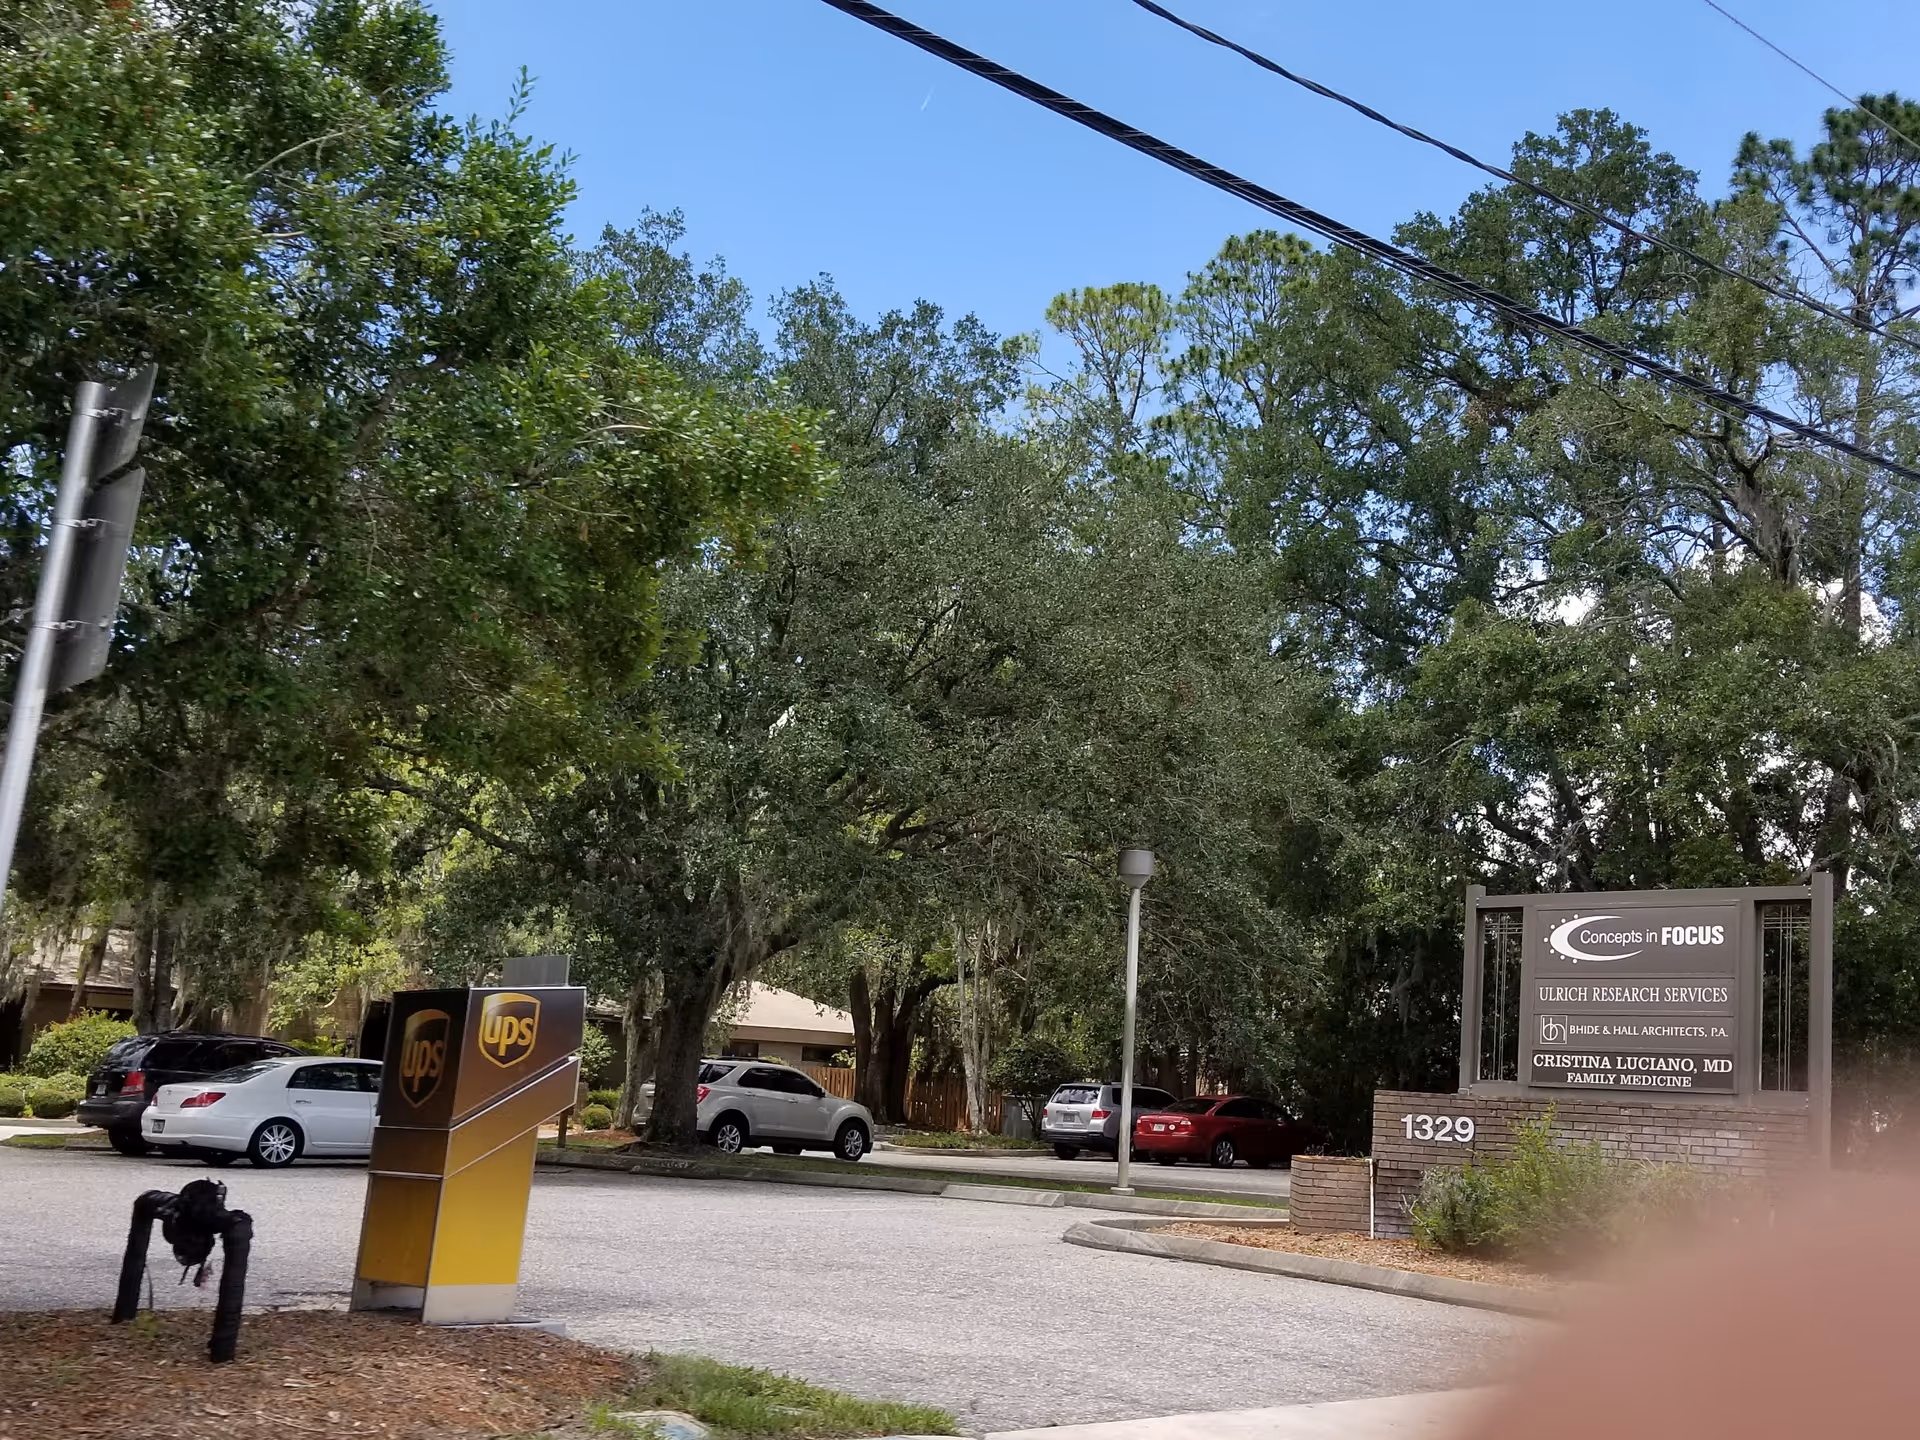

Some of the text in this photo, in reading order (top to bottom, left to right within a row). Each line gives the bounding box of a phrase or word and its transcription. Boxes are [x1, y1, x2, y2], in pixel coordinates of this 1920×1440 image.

[1580, 926, 1724, 947] Concepts in FOCUS
[1539, 986, 1728, 1003] ULRICH RESEARCH SERVICES
[1569, 1025, 1728, 1038] BHIDE & HALL ARCHITECTS, P.A.
[1533, 1054, 1733, 1074] CRISTINA LUCIANO, MD
[1566, 1072, 1692, 1087] FAMILY MEDICINE
[1401, 1114, 1475, 1142] 1329
